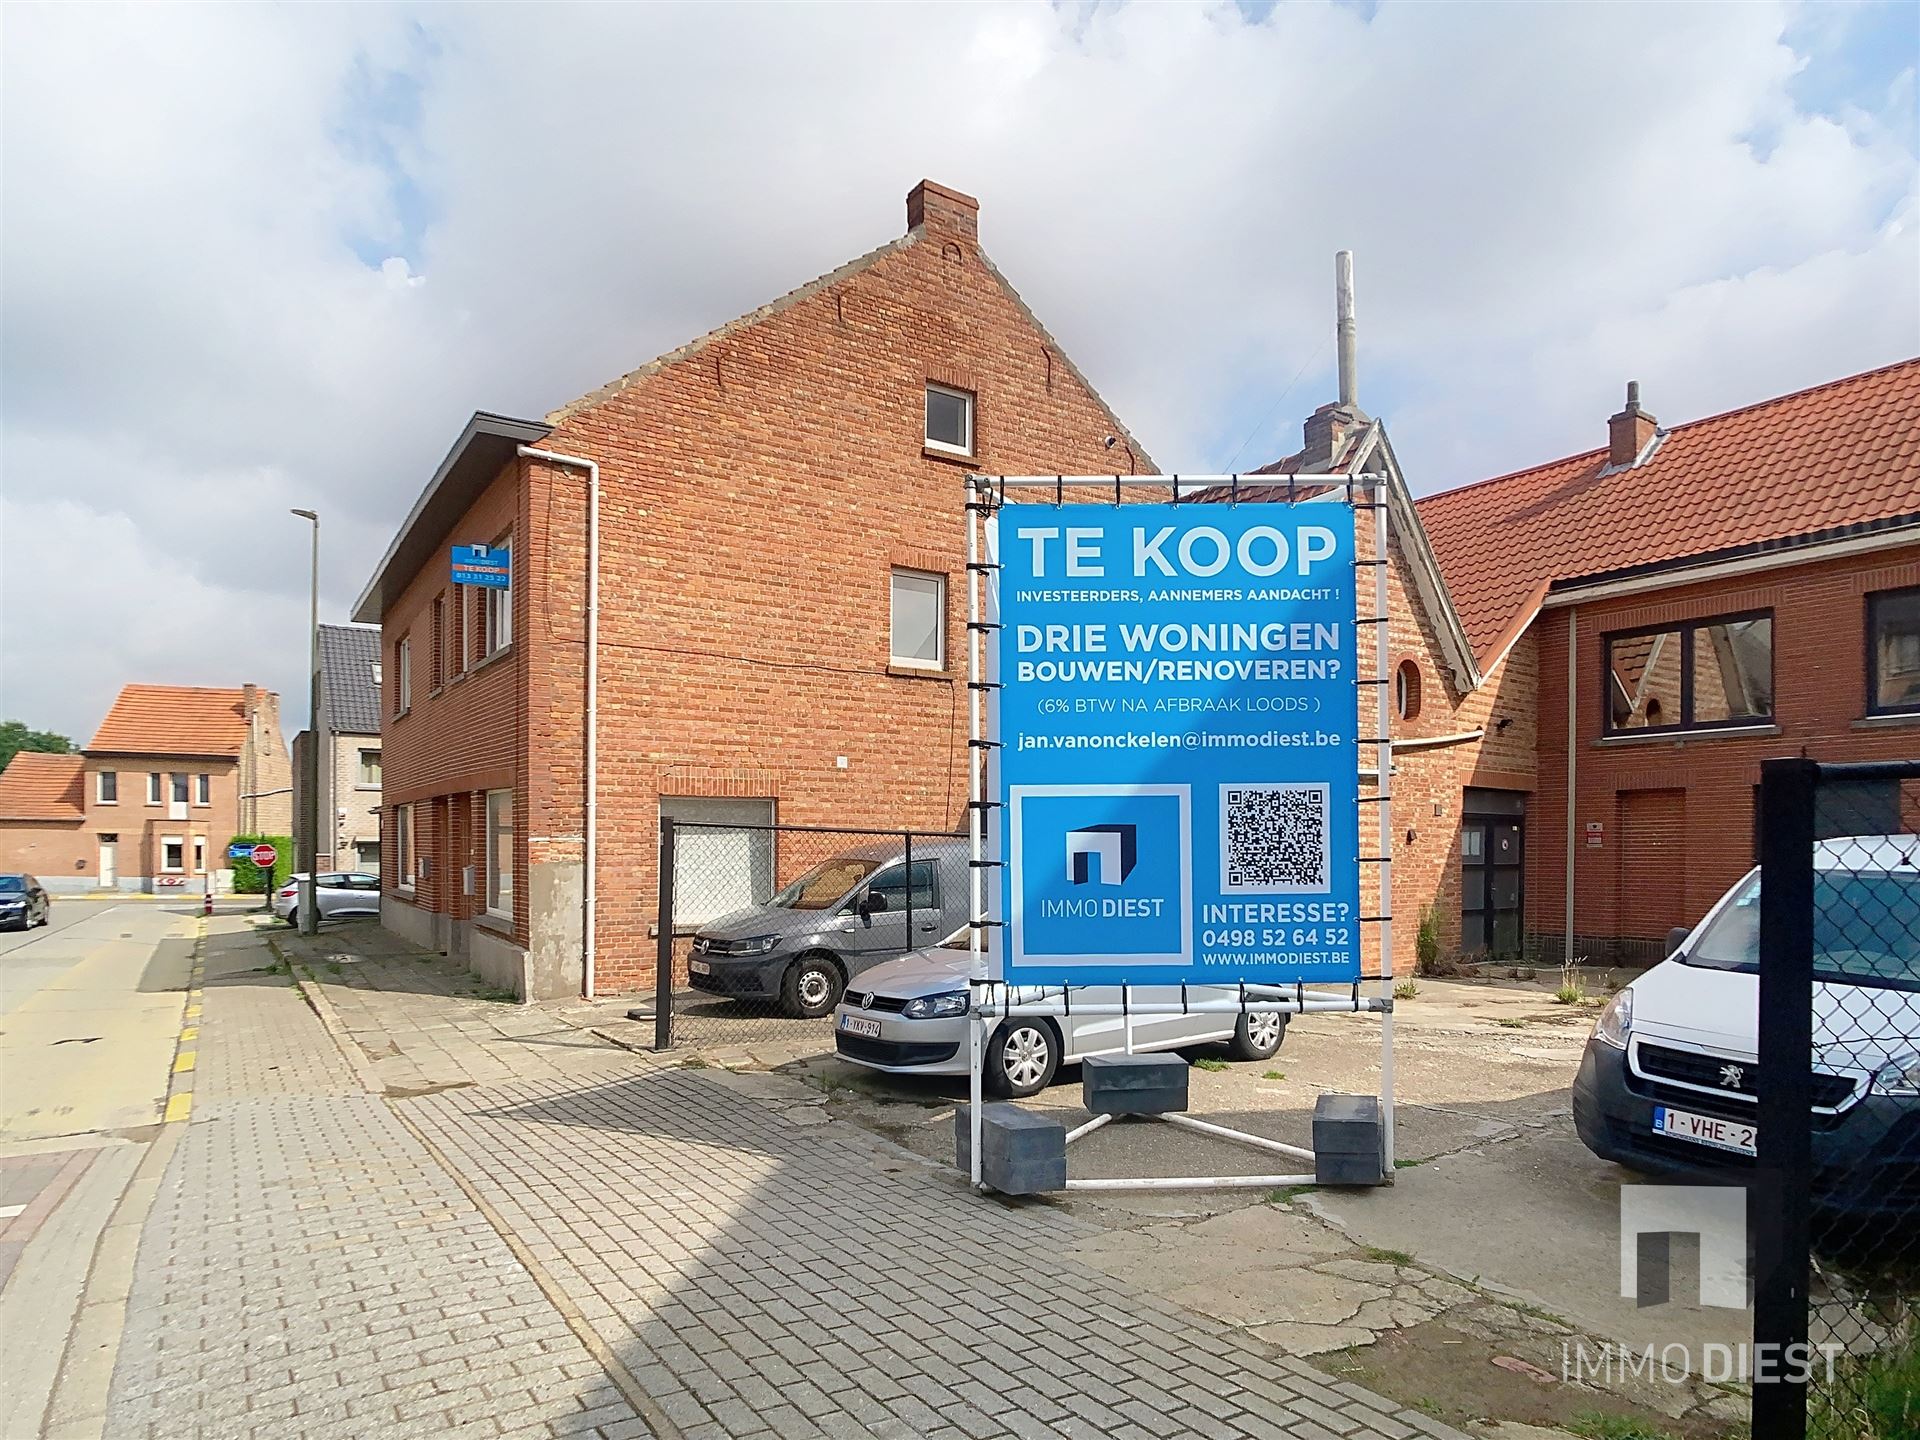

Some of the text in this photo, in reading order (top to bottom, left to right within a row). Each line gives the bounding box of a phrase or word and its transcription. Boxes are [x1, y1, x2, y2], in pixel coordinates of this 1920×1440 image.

[1017, 526, 1337, 578] TE KOOP
[1017, 588, 1340, 603] INVESTEERDERS, AANNEMERS AANDACHT !
[1017, 623, 1339, 653] DRIE WONINGEN
[1018, 658, 1341, 684] BOUWEN/RENOVEREN?
[1038, 697, 1321, 713] (6% BTW NA AFBRAAK LOODS )
[1018, 731, 1341, 751] jan.vanonckelen@immodiest.be
[1041, 899, 1164, 918] IMMO DIEST
[1202, 903, 1350, 924] INTERESSE?
[1202, 928, 1348, 948] 0498 52 64 52
[1202, 952, 1350, 965] WWW.IMMODIEST.BE
[1655, 1120, 1663, 1128] B
[1668, 1113, 1757, 1147] 1-VHE-2
